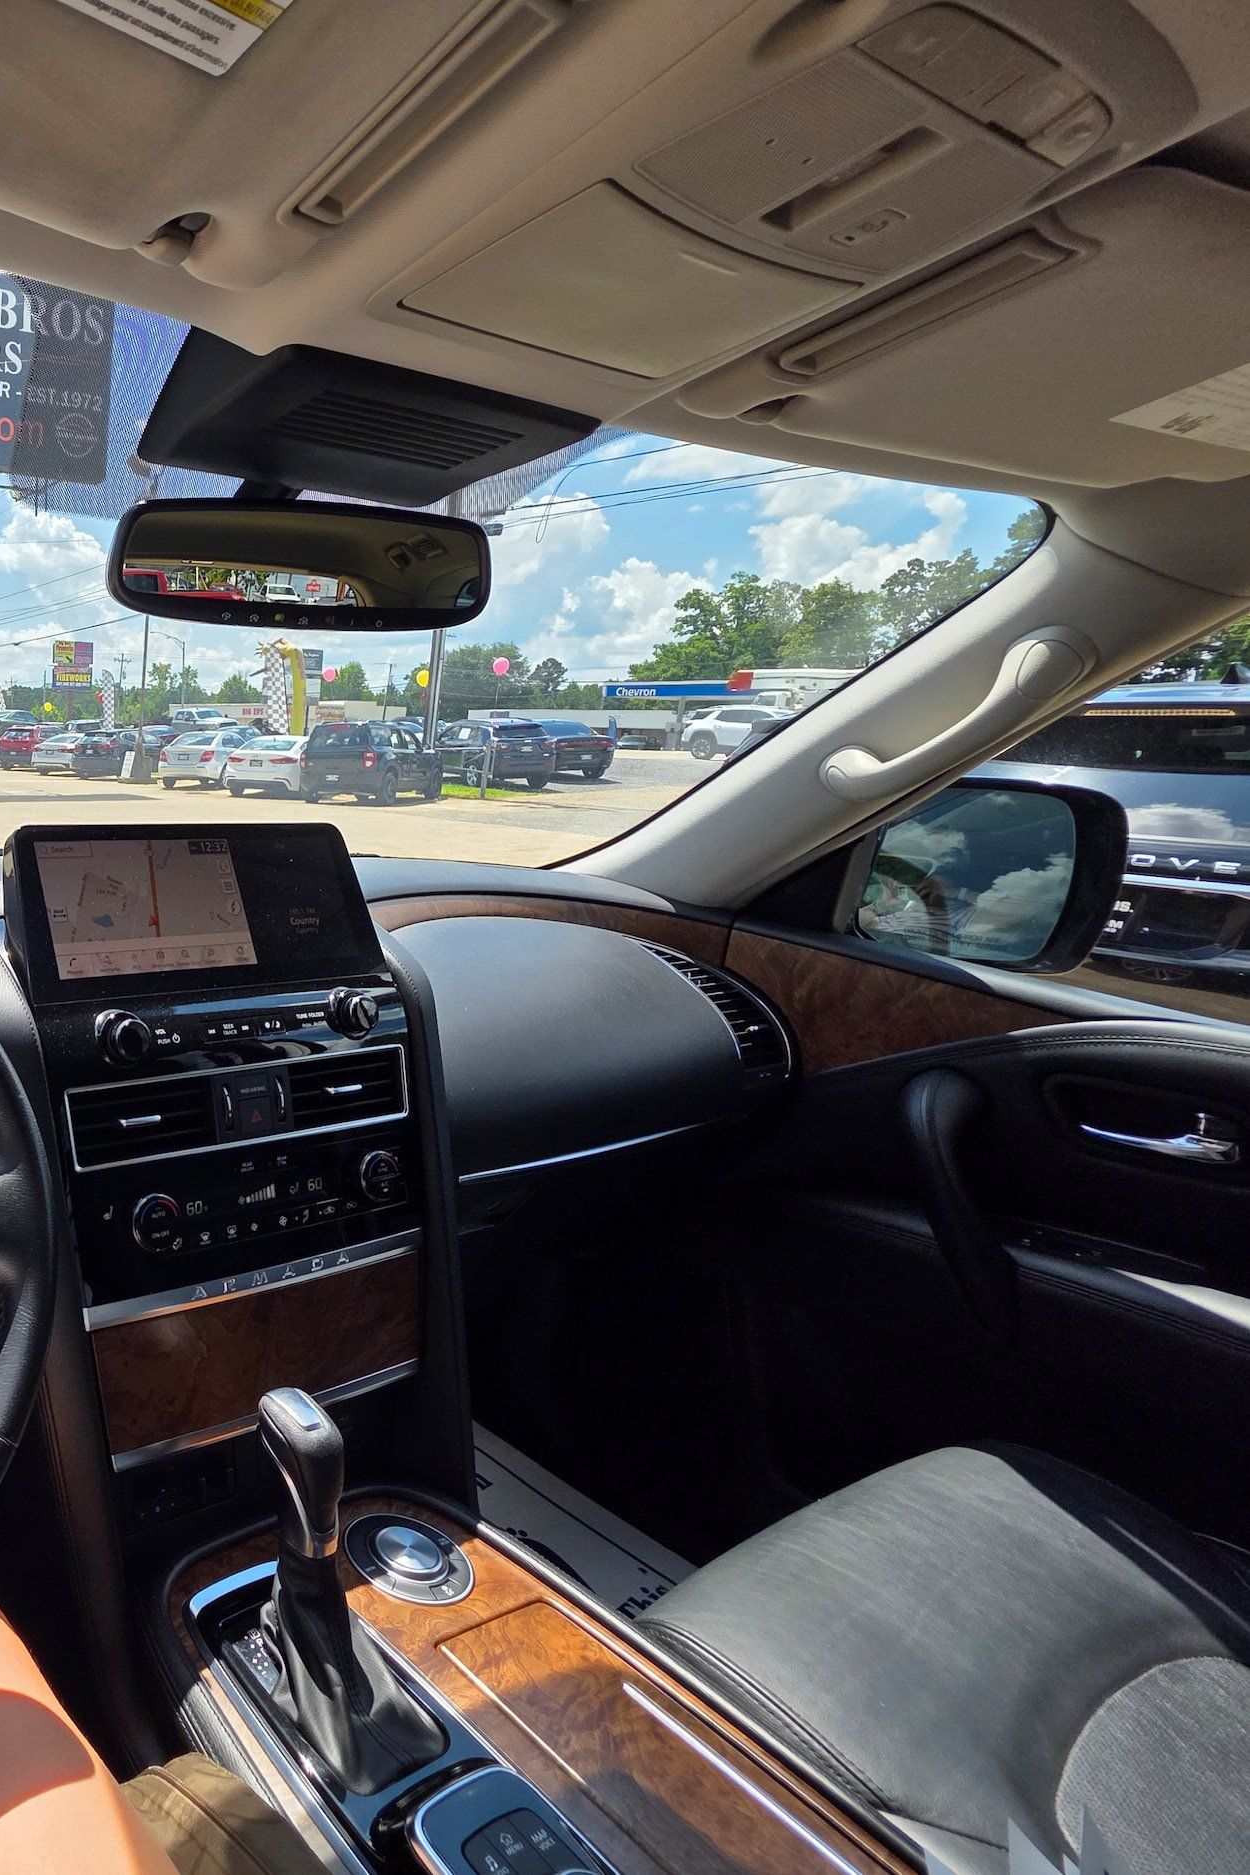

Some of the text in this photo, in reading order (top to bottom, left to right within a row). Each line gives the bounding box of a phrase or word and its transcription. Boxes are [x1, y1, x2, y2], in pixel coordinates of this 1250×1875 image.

[56, 673, 91, 682] FIREWORKS
[616, 686, 656, 696] Chevron
[200, 842, 228, 852] 12:32
[290, 917, 320, 926] Country
[308, 1178, 322, 1191] 60
[186, 1201, 202, 1216] 60
[192, 1251, 349, 1300] ARMADA
[531, 1828, 548, 1844] MAP
[505, 1842, 524, 1856] MENU
